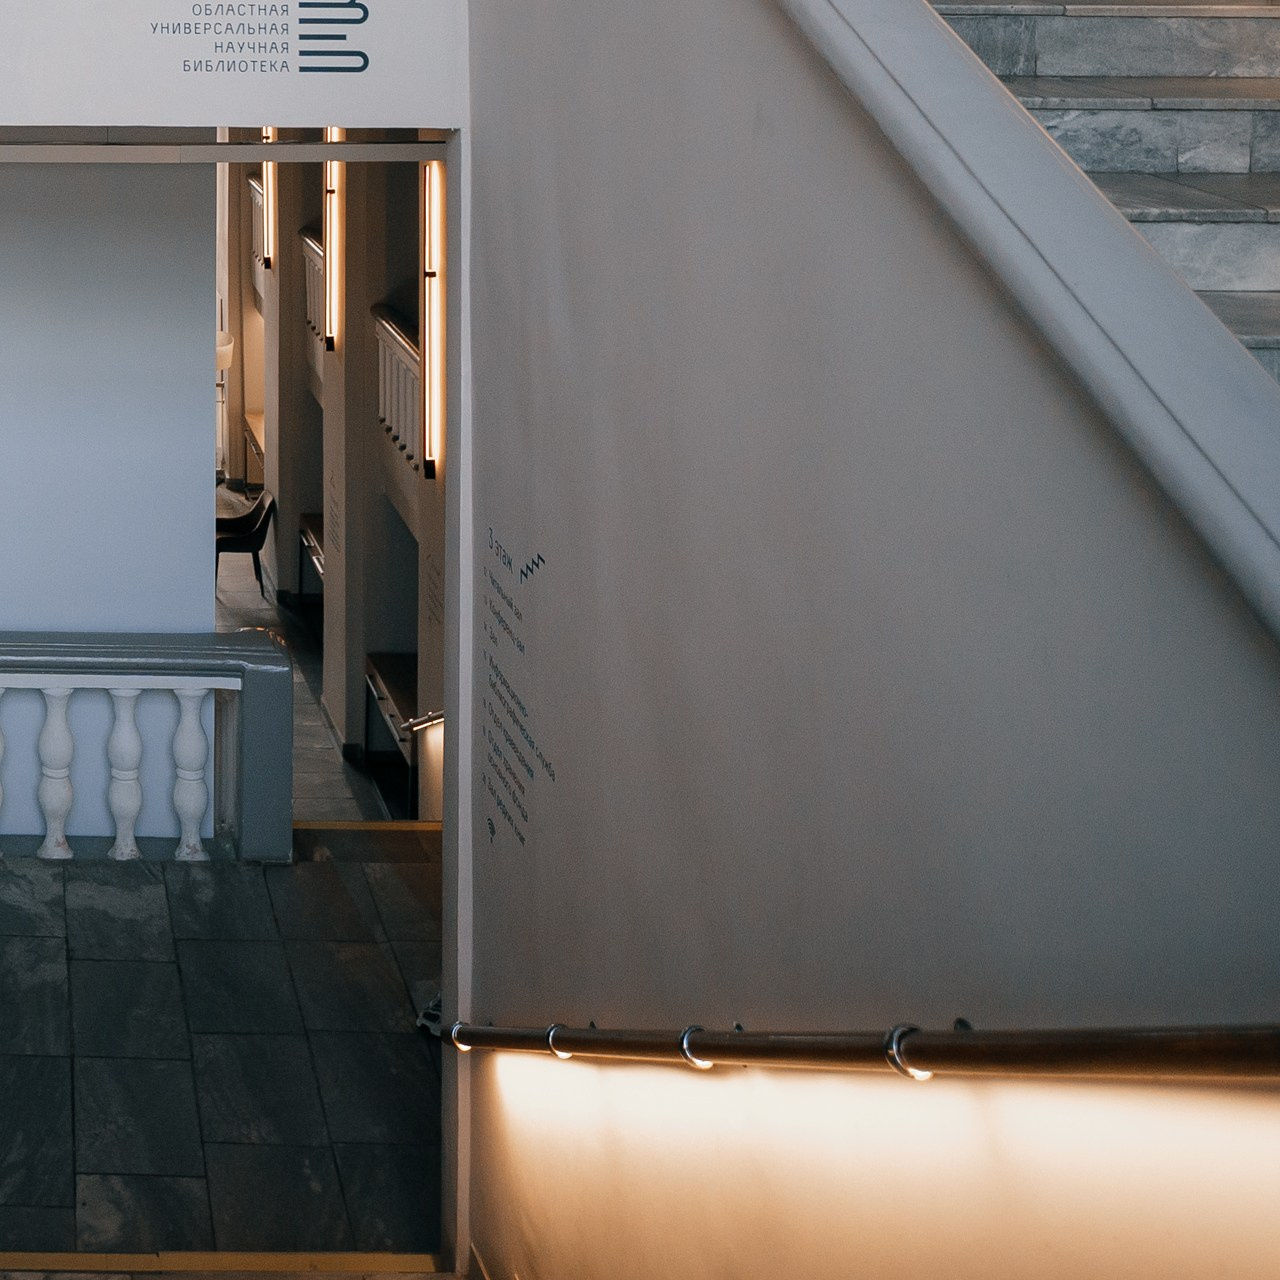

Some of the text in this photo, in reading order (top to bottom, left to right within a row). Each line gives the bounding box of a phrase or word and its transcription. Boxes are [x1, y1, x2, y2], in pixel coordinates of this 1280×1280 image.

[191, 3, 290, 17] ОБЛАСТНАЯ
[149, 22, 290, 36] УНИВЕРСАЛЬНАЯ
[214, 41, 290, 55] НАУЧНАЯ
[182, 59, 291, 74] БИБЛИОТЕКА
[488, 527, 513, 574] 3 этаж
